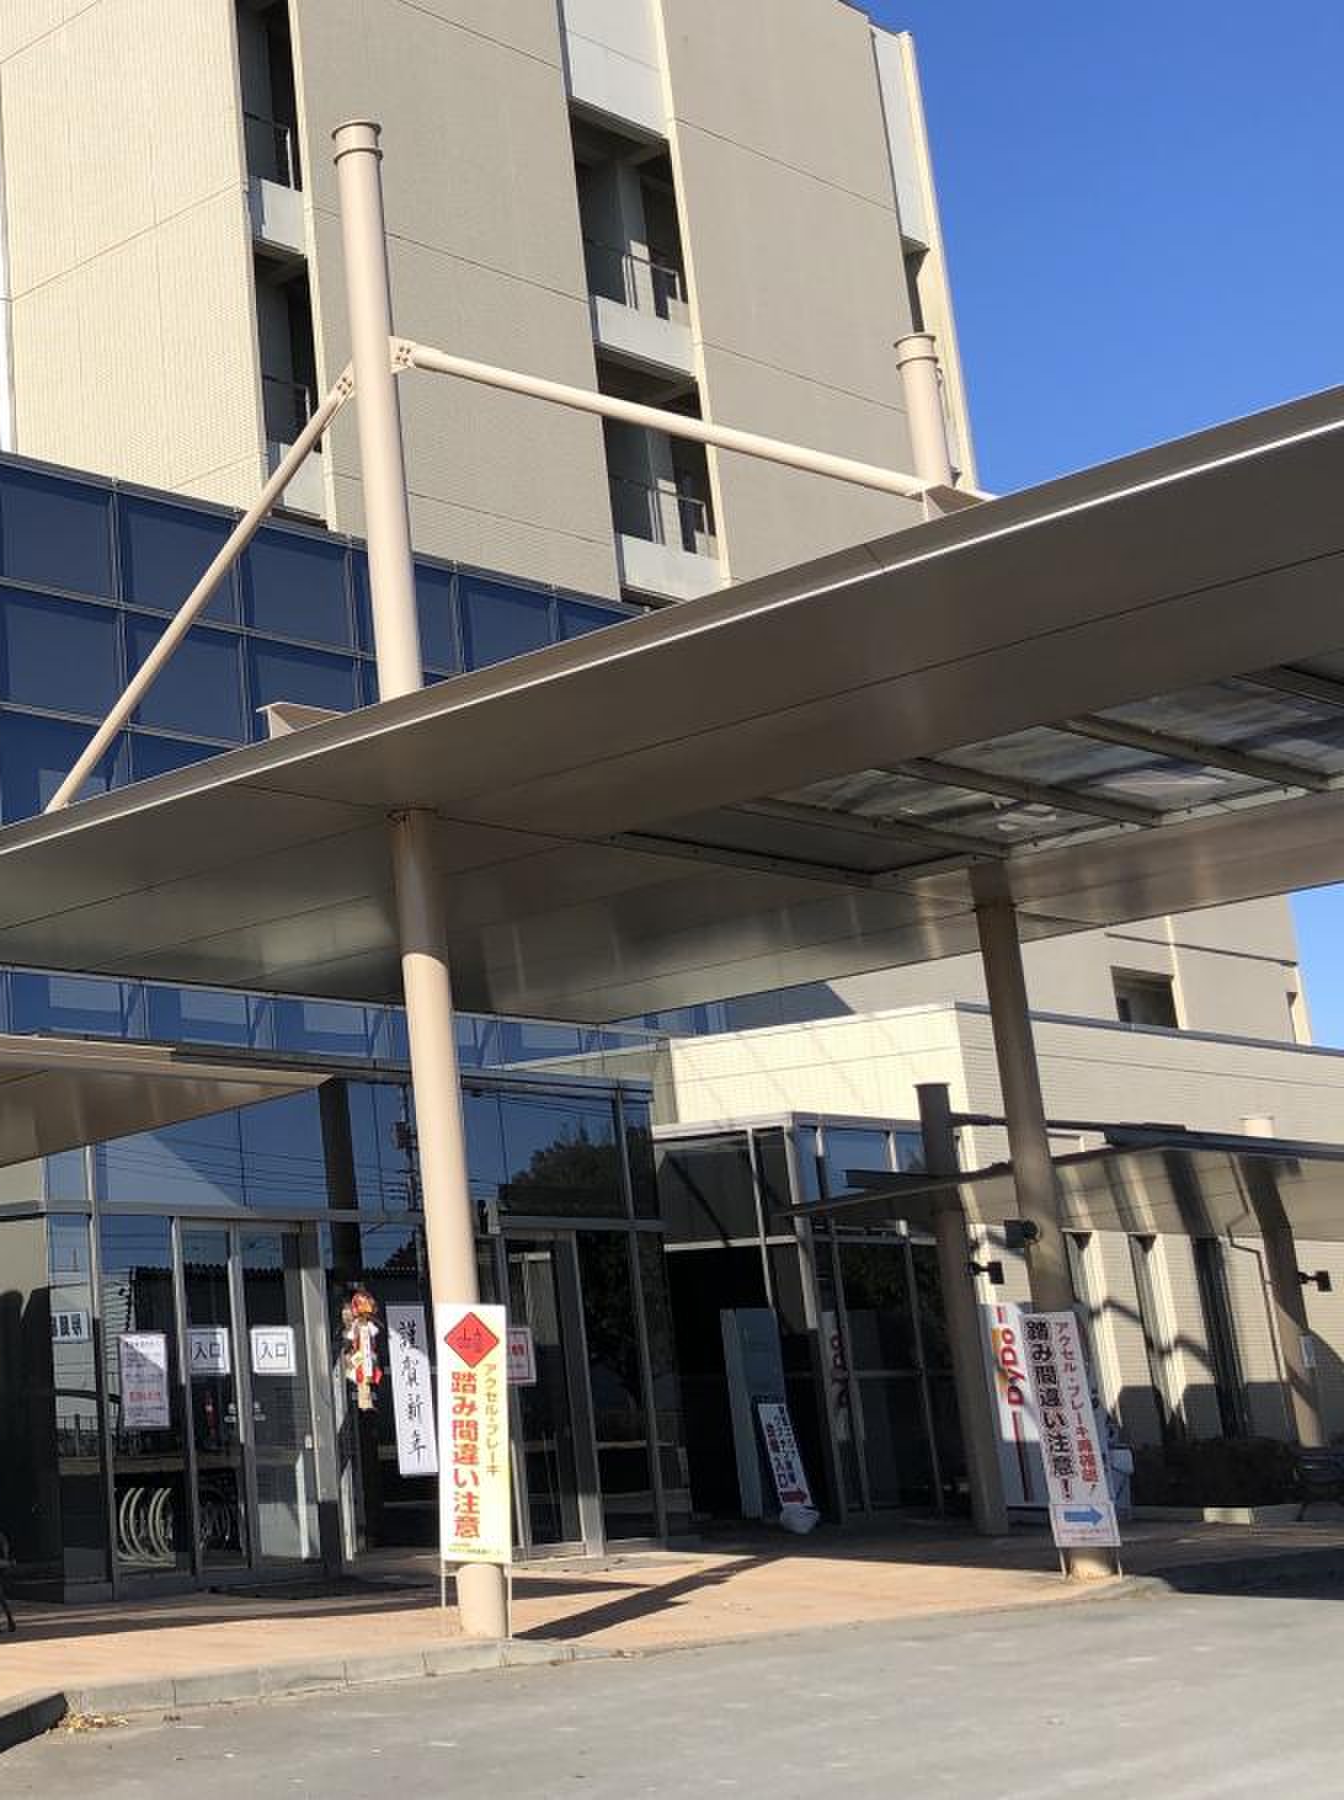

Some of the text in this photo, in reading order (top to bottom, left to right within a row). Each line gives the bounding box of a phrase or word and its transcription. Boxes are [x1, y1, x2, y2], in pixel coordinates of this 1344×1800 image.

[192, 1340, 221, 1361] 入口
[258, 1341, 288, 1361] 入口
[999, 1327, 1025, 1406] DyDo
[451, 1371, 481, 1539] 踏み間違い注意
